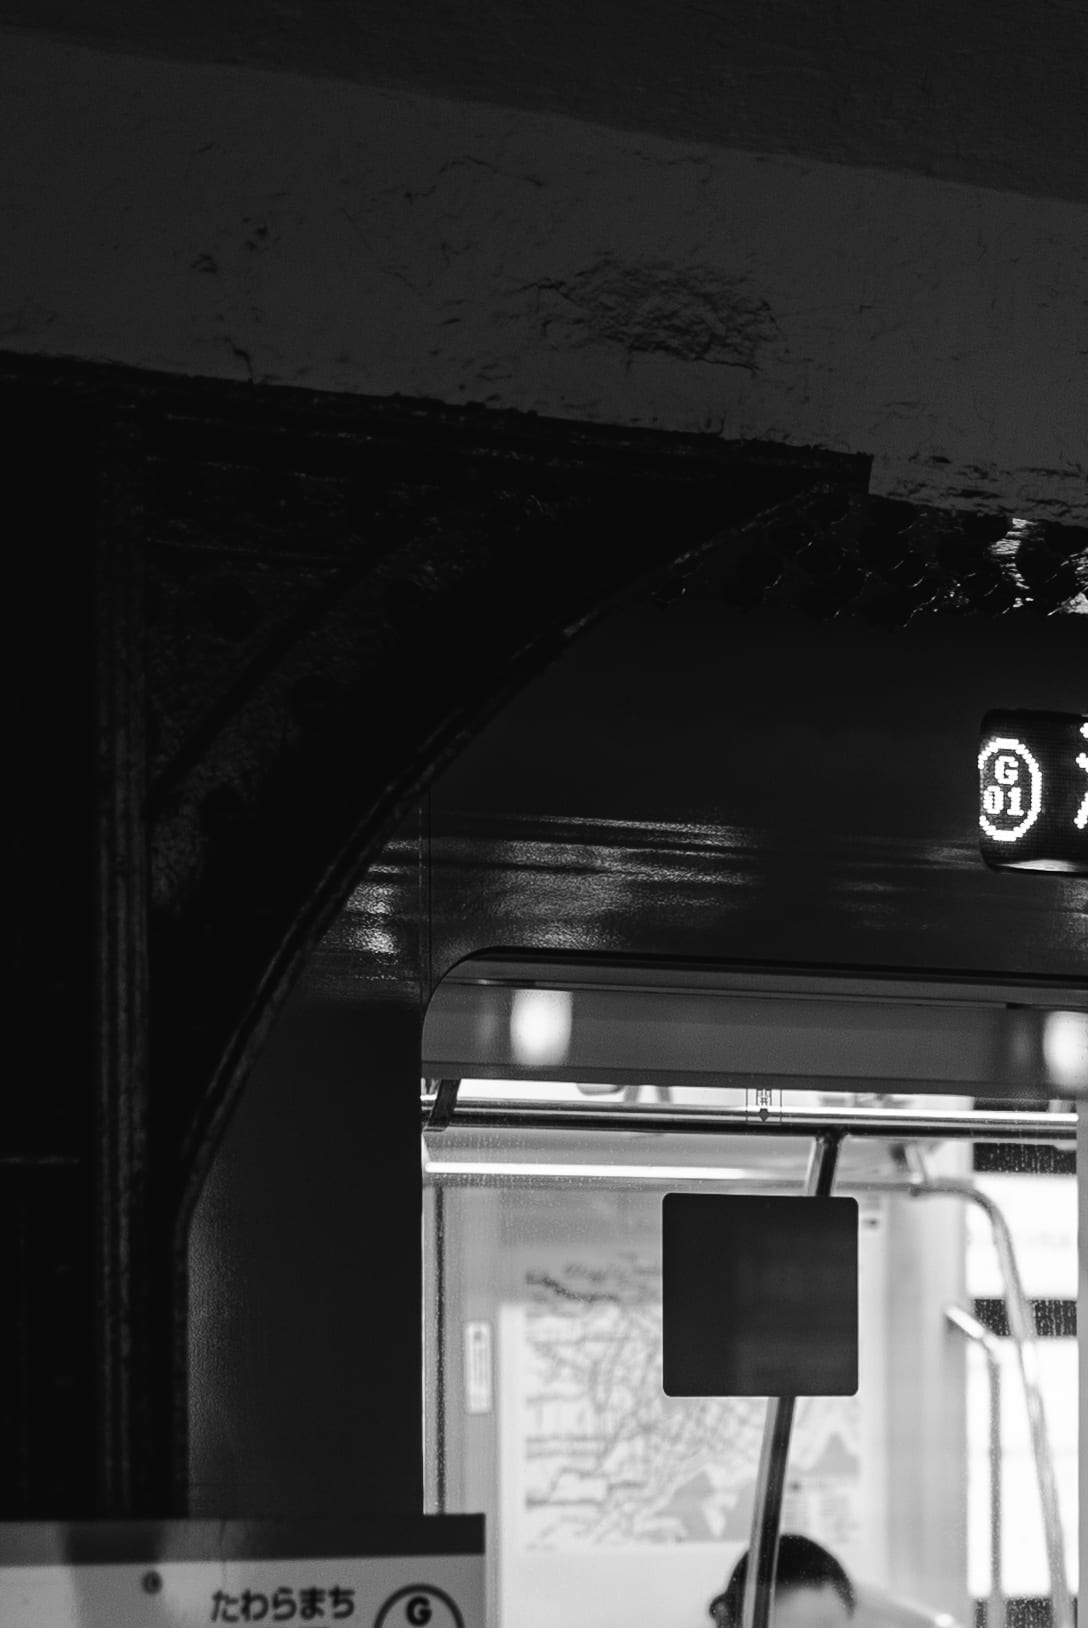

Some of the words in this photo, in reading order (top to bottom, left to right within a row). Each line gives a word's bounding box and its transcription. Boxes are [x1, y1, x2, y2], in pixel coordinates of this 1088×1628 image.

[994, 755, 1019, 784] G
[983, 786, 1025, 816] 01
[210, 1586, 355, 1623] たわらまち
[405, 1596, 433, 1627] G
